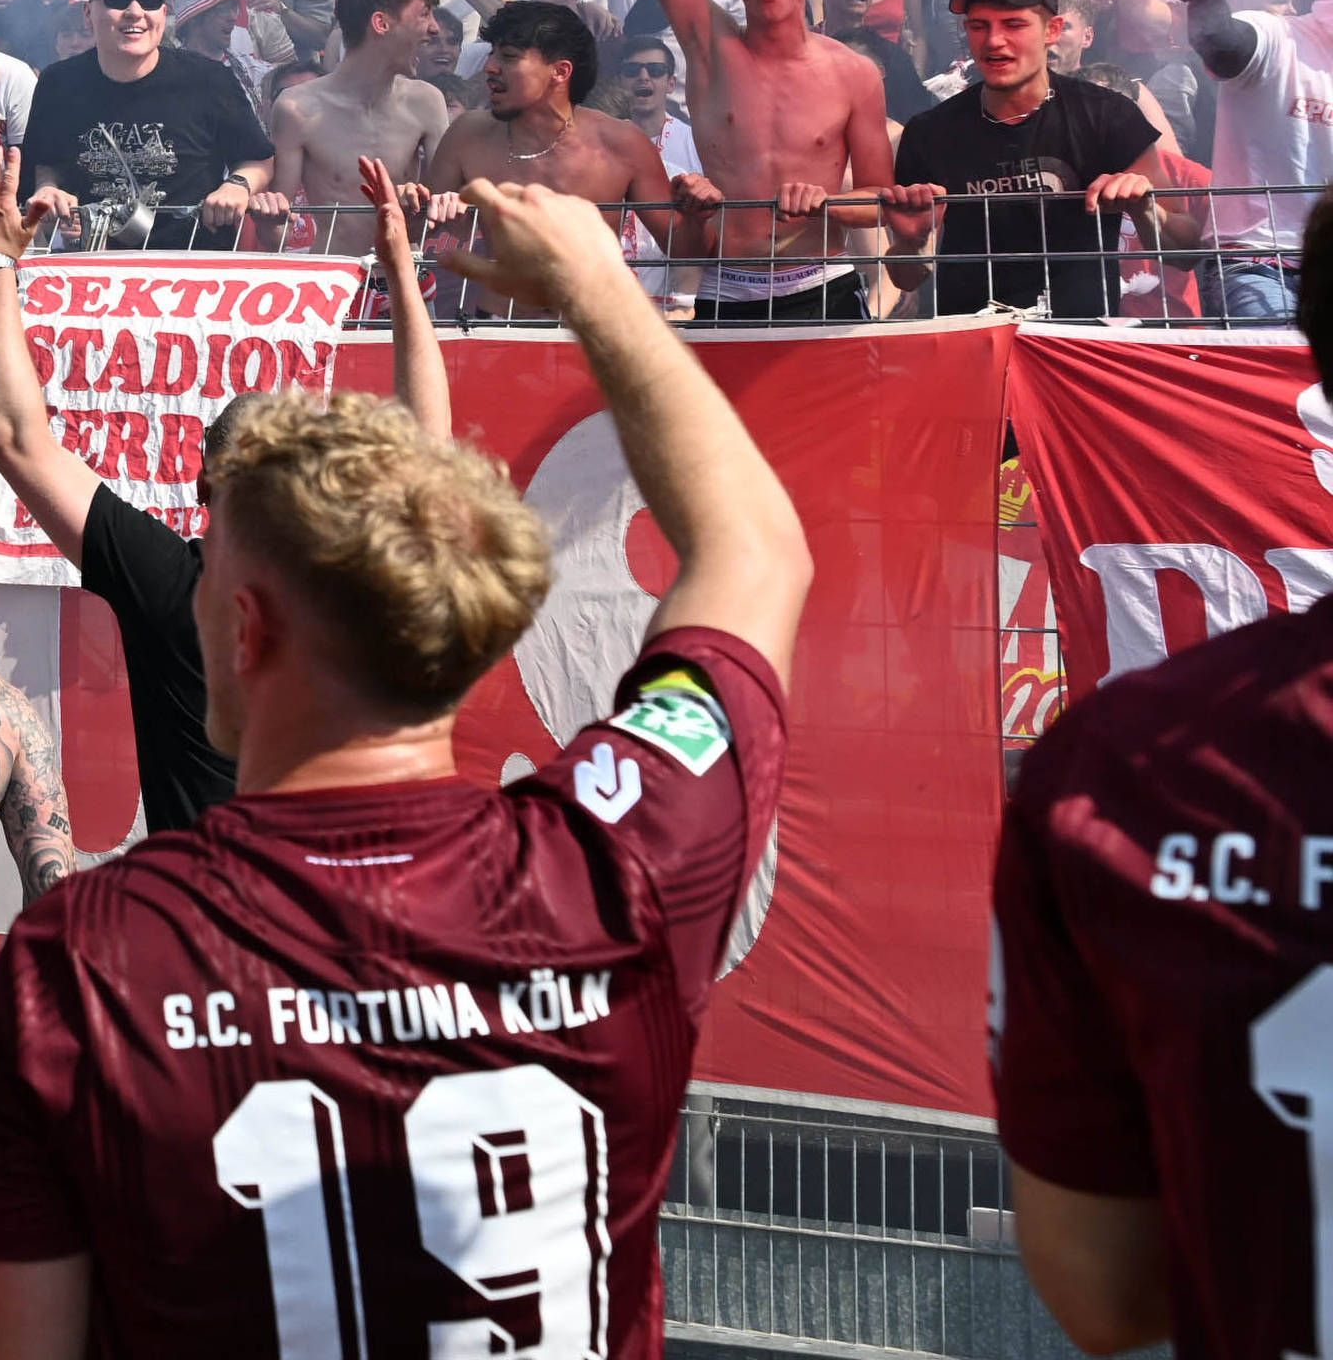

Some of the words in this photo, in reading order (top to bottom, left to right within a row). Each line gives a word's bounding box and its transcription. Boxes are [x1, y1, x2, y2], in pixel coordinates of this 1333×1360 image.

[966, 172, 1042, 195] NORTH
[997, 157, 1039, 176] THE
[23, 274, 360, 328] SEKTION
[23, 324, 336, 400] STADION
[47, 407, 204, 484] ERB
[47, 811, 70, 836] BFC
[1150, 832, 1271, 905] S.C.
[163, 991, 252, 1050] S.C.
[269, 984, 487, 1044] FORTUNA
[499, 969, 613, 1034] KÖLN
[212, 1064, 613, 1360] 19
